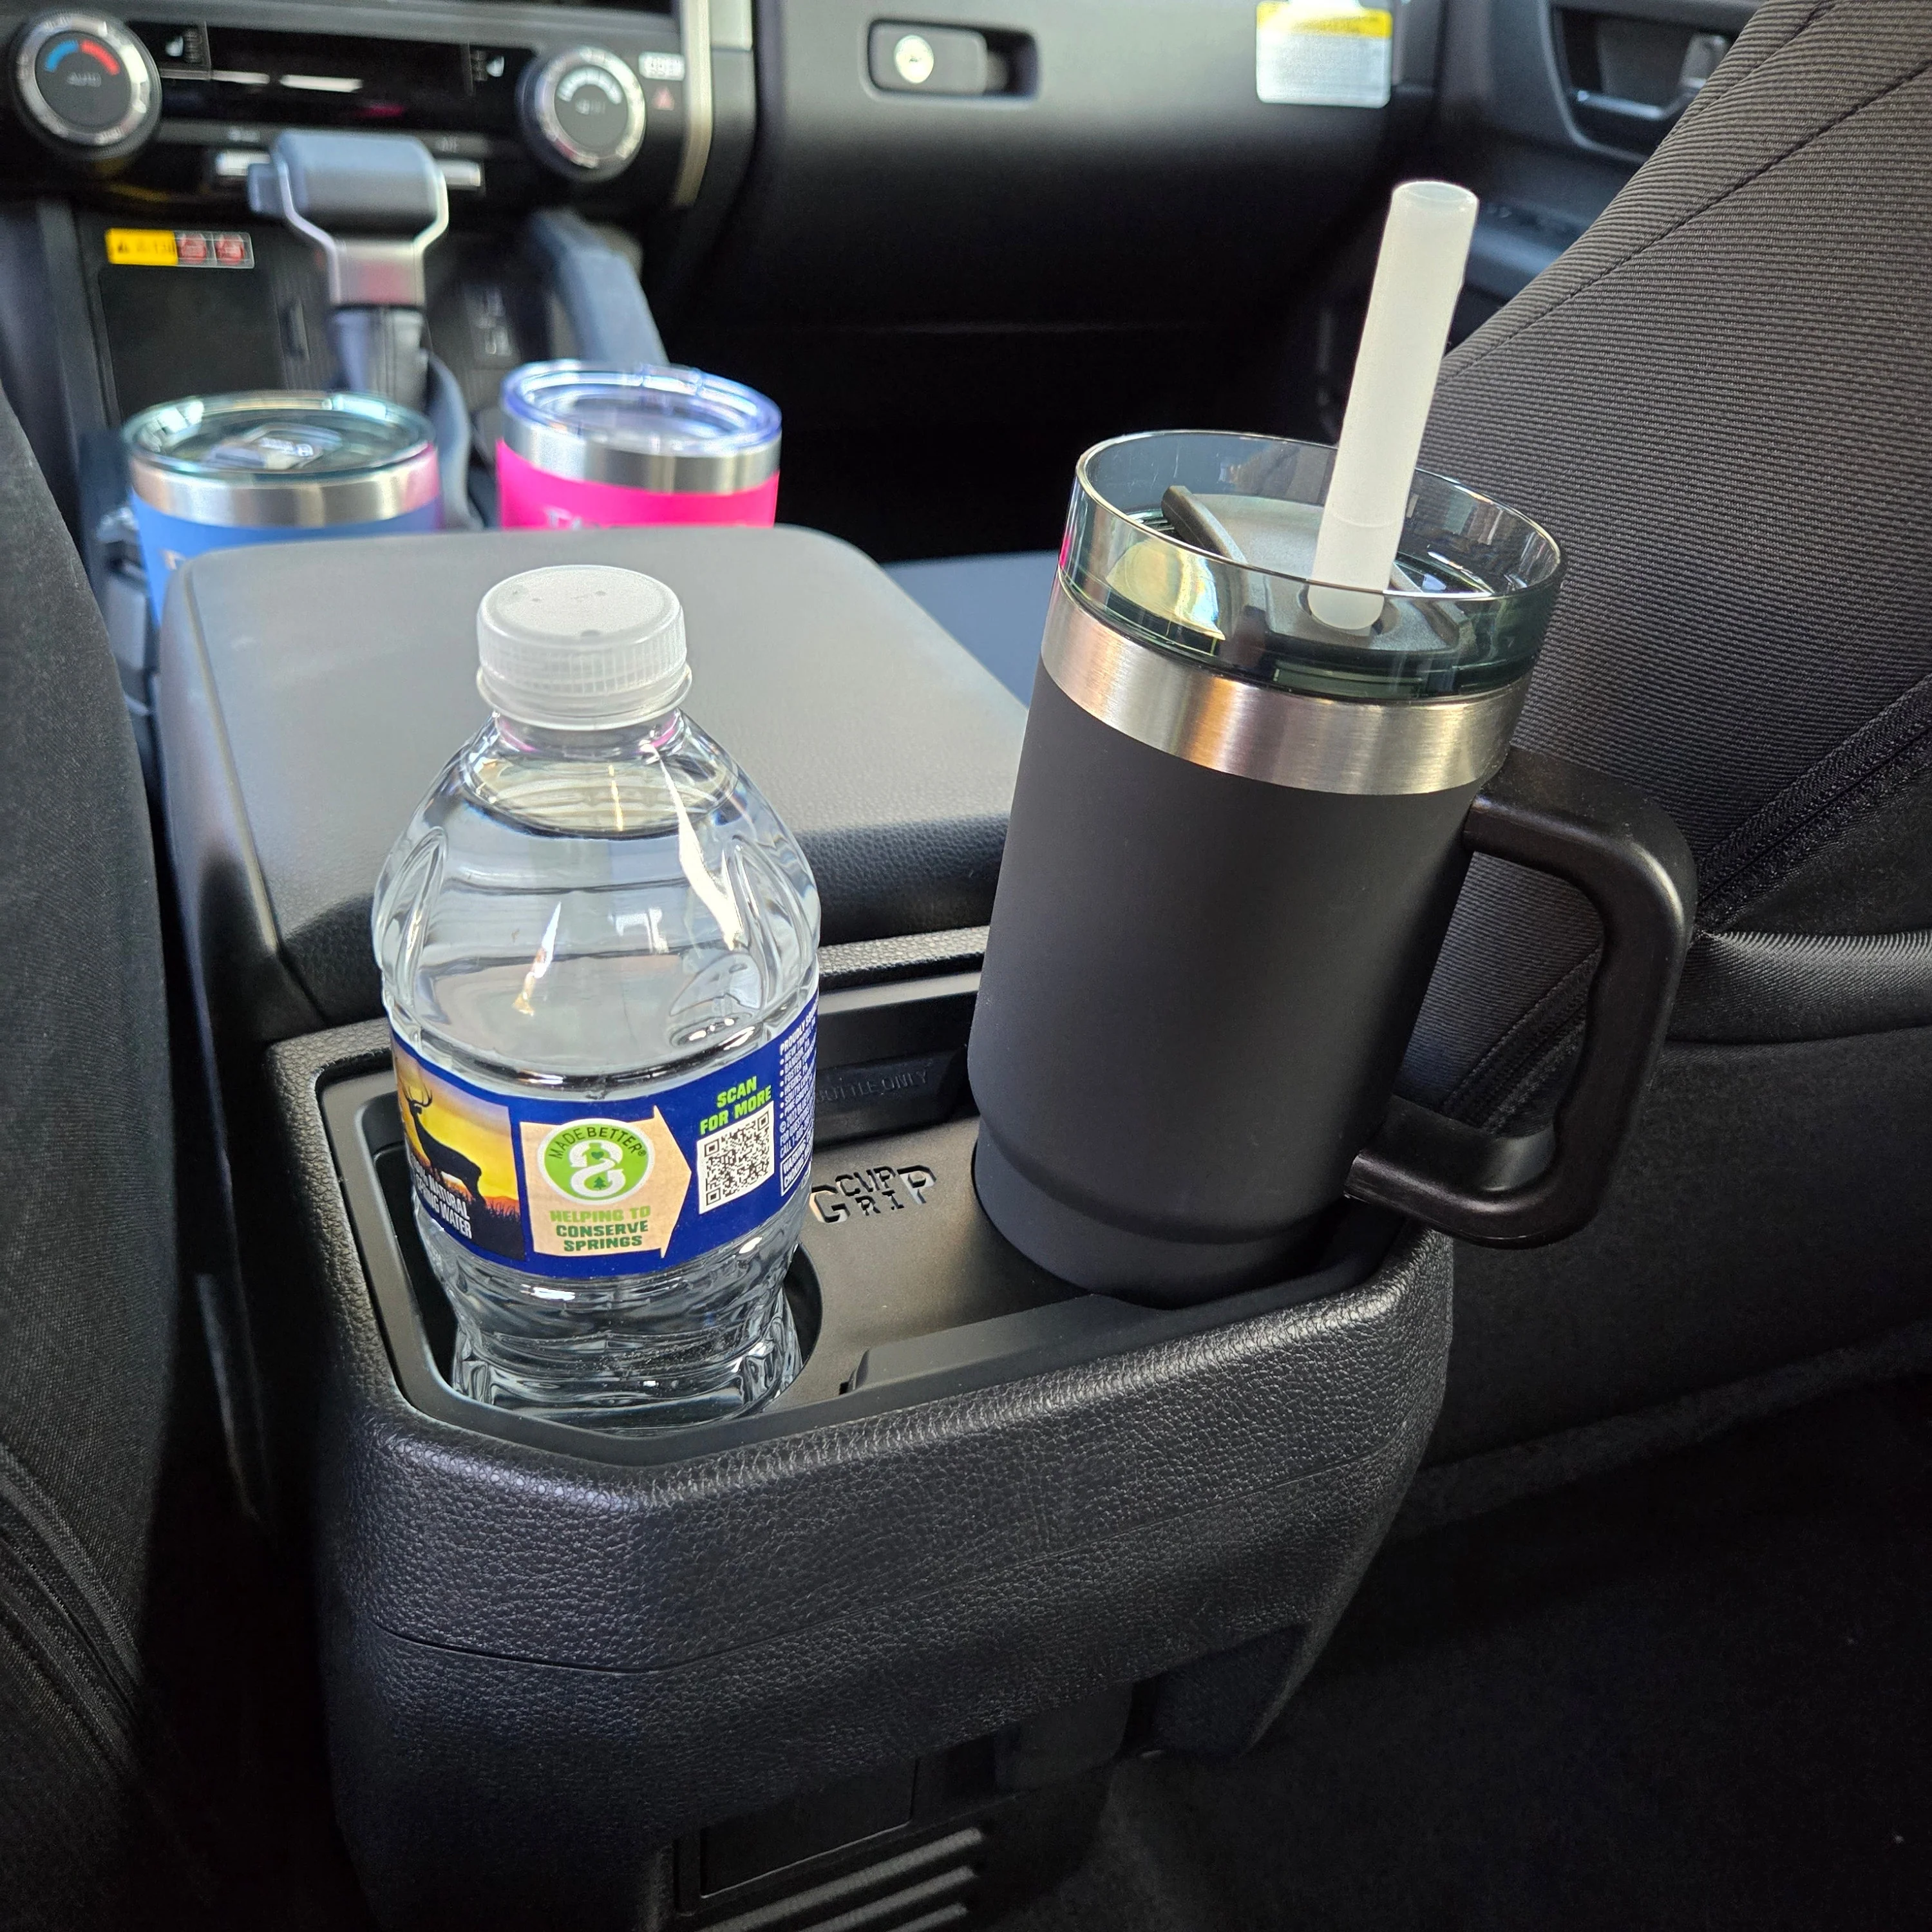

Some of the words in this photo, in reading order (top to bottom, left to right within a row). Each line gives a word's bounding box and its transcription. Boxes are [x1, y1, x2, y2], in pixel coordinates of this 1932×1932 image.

[780, 1020, 805, 1056] PROUDLY
[785, 1043, 797, 1064] NEW
[717, 1075, 757, 1108] SCAN
[881, 1069, 928, 1090] ONLY
[700, 1110, 728, 1135] FOR
[735, 1085, 772, 1119] MORE
[549, 1128, 585, 1160] MADE
[781, 1140, 792, 1159] CALL
[835, 1166, 896, 1197] CUP
[428, 1174, 470, 1221] NATURAL
[439, 1200, 472, 1239] WATER
[550, 1209, 625, 1223] HELPING
[629, 1206, 651, 1219] TO
[556, 1220, 649, 1237] CONSERVE
[564, 1235, 643, 1252] SPRINGS
